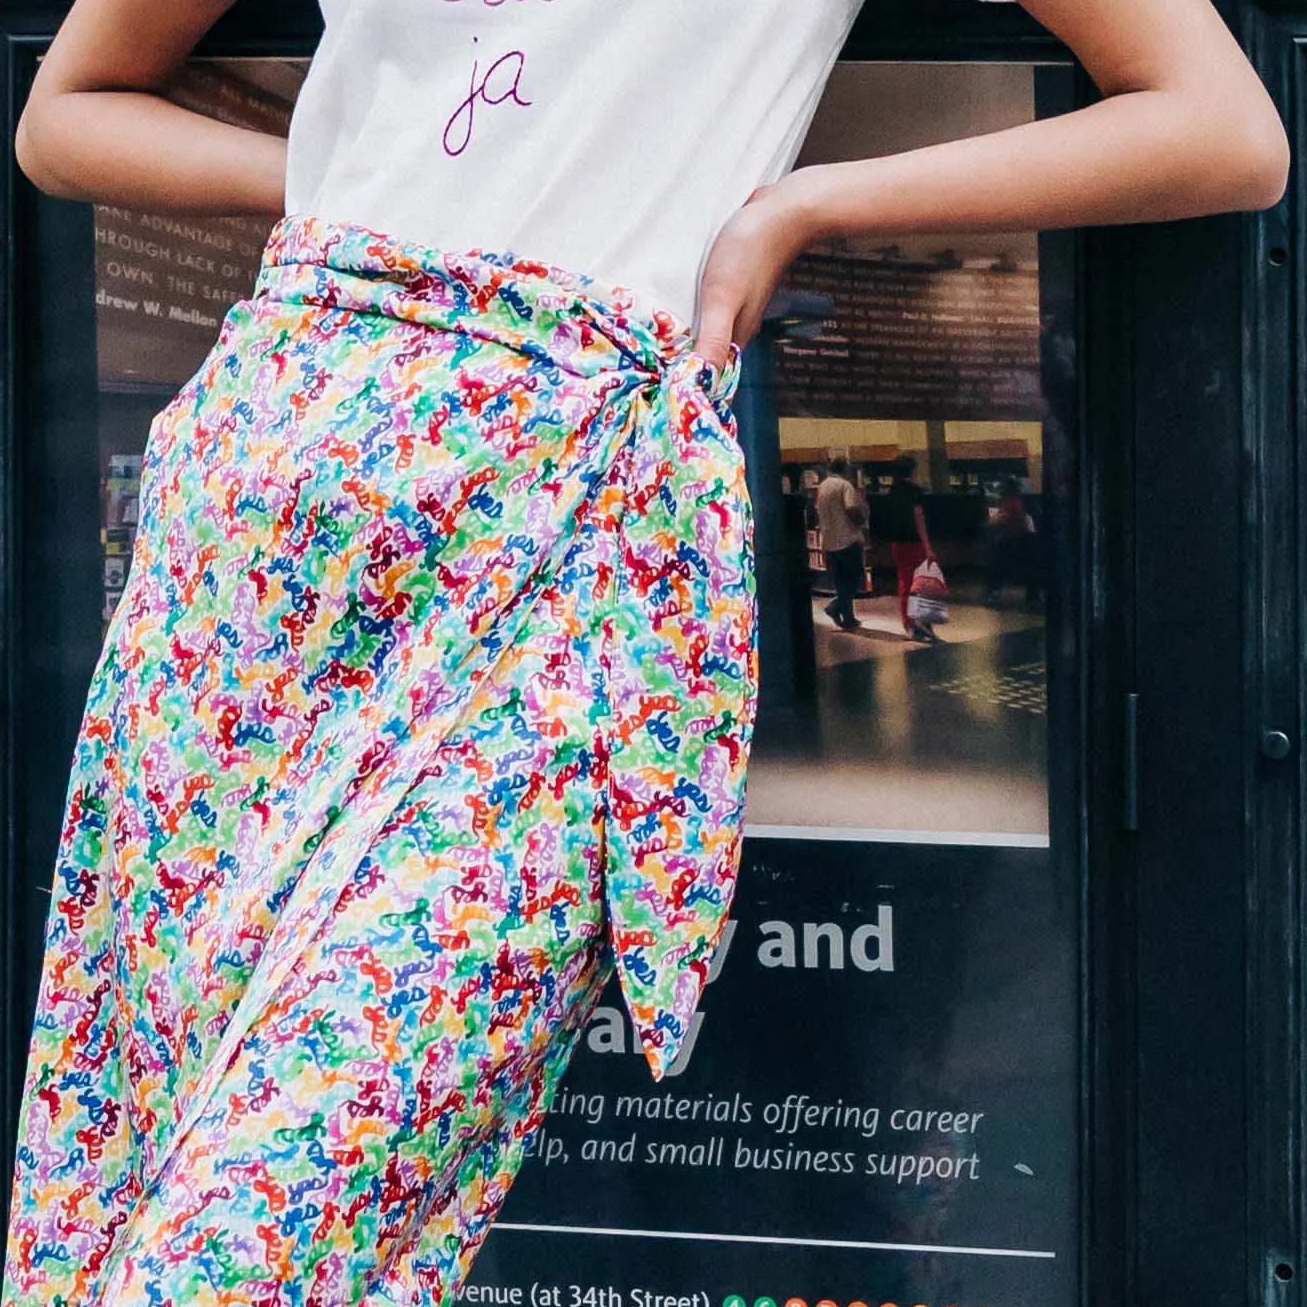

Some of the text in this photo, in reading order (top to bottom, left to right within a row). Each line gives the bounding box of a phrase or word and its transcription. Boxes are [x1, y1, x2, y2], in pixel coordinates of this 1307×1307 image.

[442, 36, 532, 157] ja
[757, 902, 896, 973] and
[615, 1092, 753, 1124] materials
[763, 1094, 880, 1138] offering
[890, 1108, 985, 1135] career
[581, 1132, 637, 1163] and
[645, 1136, 724, 1168] small
[734, 1137, 855, 1175] business
[865, 1150, 981, 1186] support
